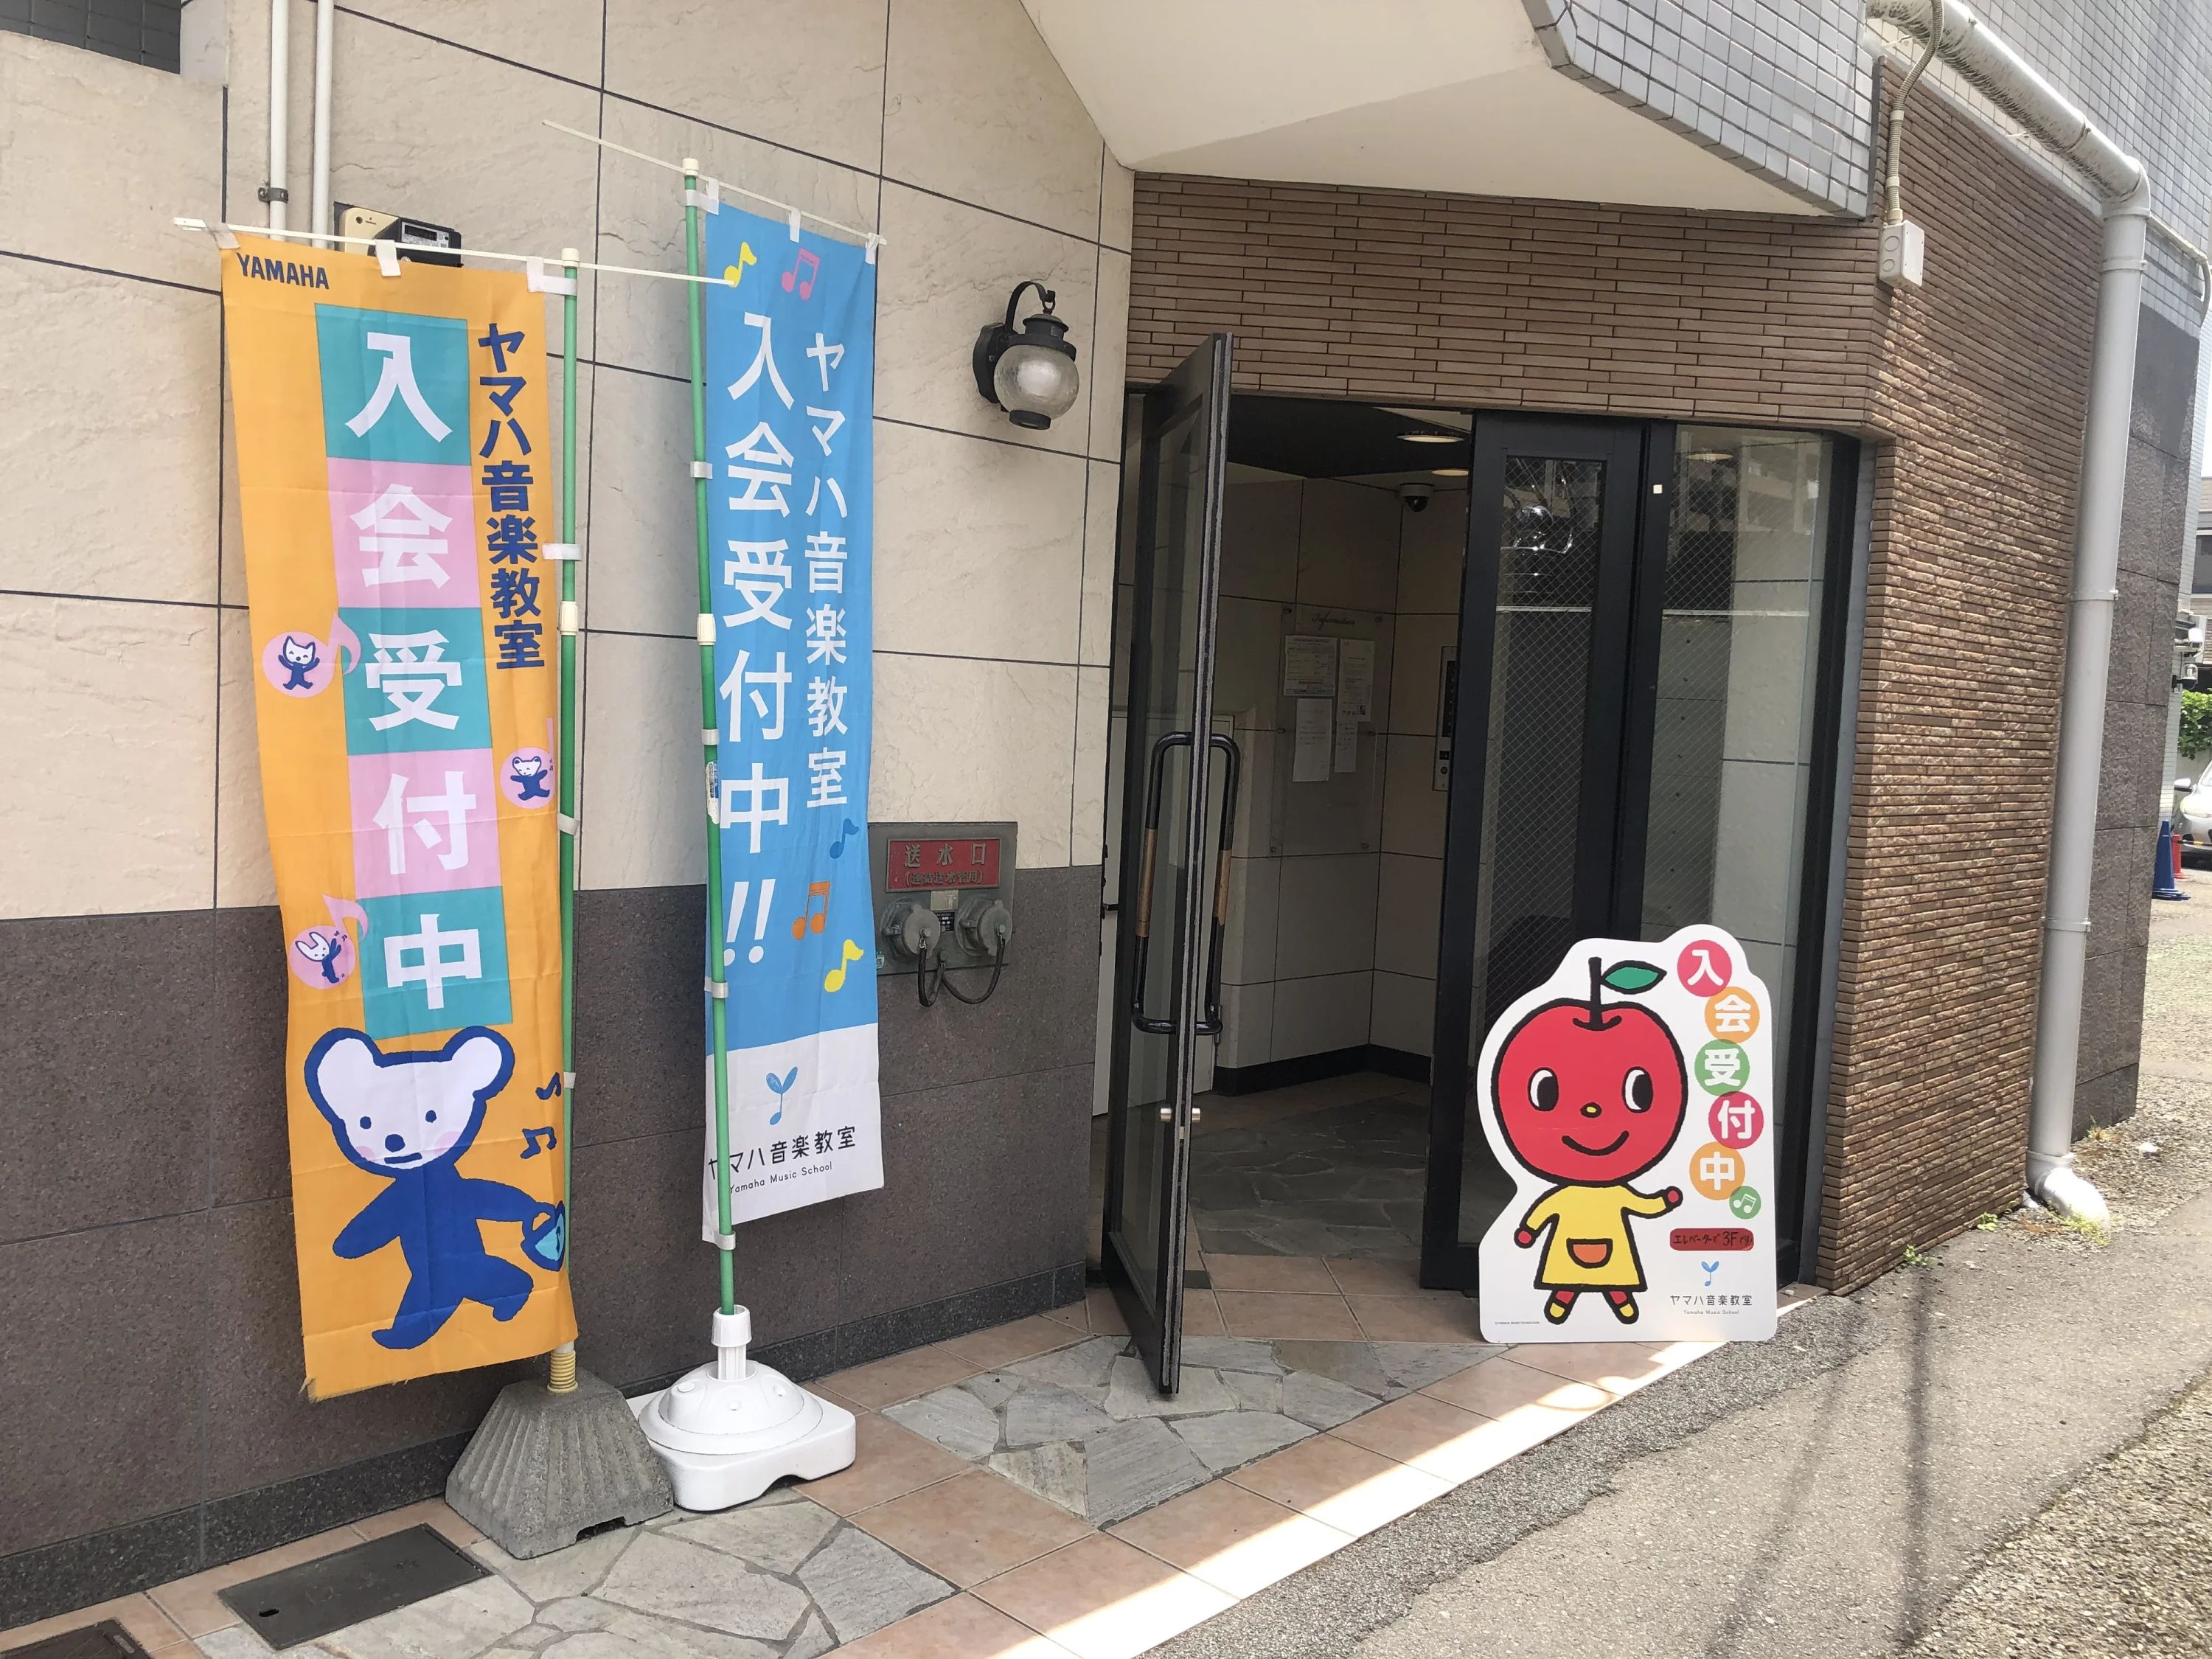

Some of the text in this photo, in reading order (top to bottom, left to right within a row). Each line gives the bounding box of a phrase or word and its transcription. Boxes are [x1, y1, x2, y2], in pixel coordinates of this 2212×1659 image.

[236, 252, 330, 290] YAMAHA
[478, 322, 546, 670] ヤマハ音楽教室
[804, 333, 849, 809] ヤマハ音楽教室
[345, 331, 484, 1009] 入会受付中
[904, 842, 986, 868] 送水口
[1687, 949, 1755, 1190] 入会受付中
[770, 1169, 797, 1183] Music
[801, 1161, 832, 1176] School
[1670, 1295, 1753, 1306] ヤマハ音楽教室
